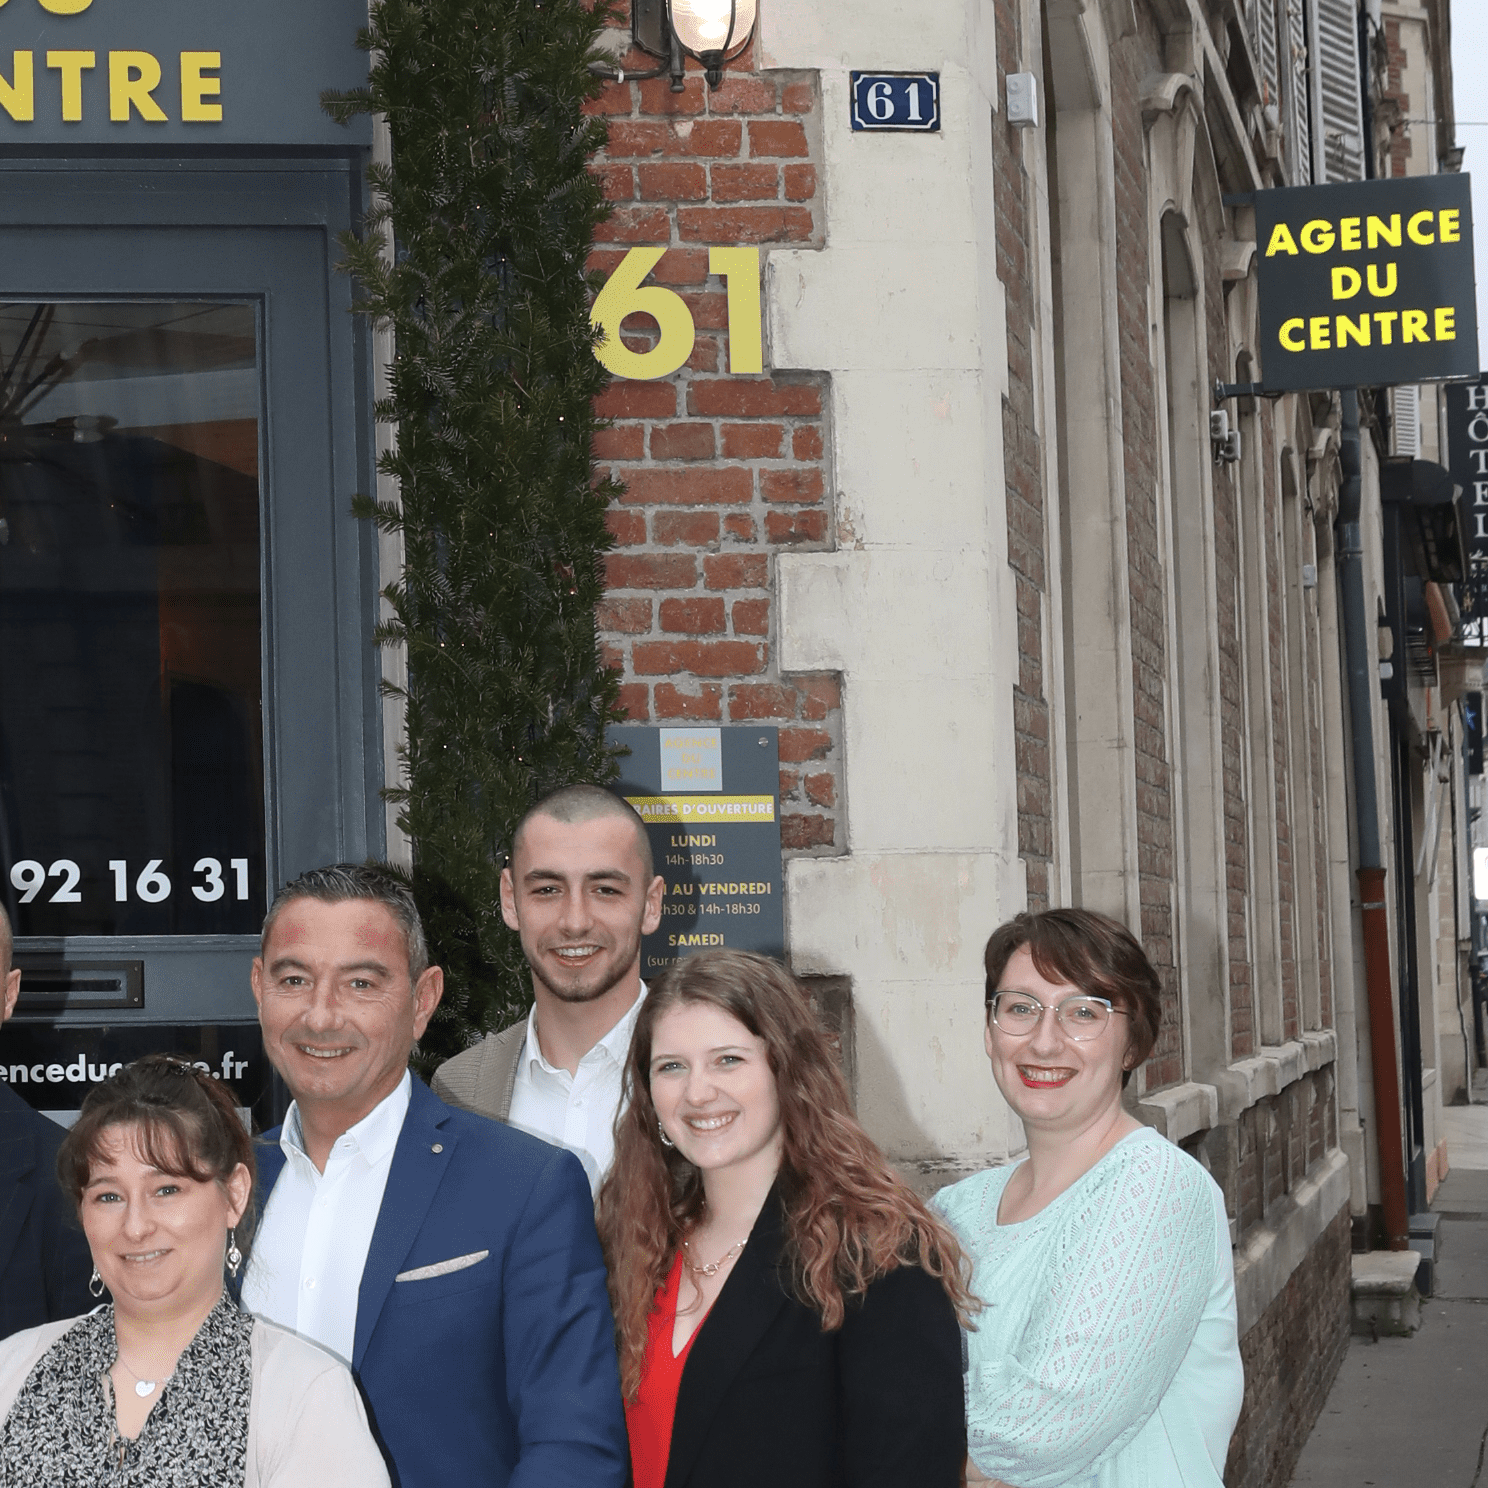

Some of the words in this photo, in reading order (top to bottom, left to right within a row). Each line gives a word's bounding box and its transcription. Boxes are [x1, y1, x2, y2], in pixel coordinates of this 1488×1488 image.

[866, 81, 924, 121] 61
[1264, 208, 1461, 258] AGENCE
[1330, 261, 1399, 301] DU
[589, 246, 763, 381] 61
[1277, 305, 1457, 353] CENTRE
[633, 803, 678, 815] RAIRES
[670, 834, 717, 847] LUNDI
[665, 853, 725, 866] 14h-18h30
[10, 859, 82, 904] 92
[109, 859, 172, 903] 16
[191, 857, 249, 902] 31
[672, 883, 694, 896] AU
[698, 882, 772, 895] VENDREDI
[700, 902, 761, 915] 14h-18h30
[668, 933, 725, 947] SAMEDI
